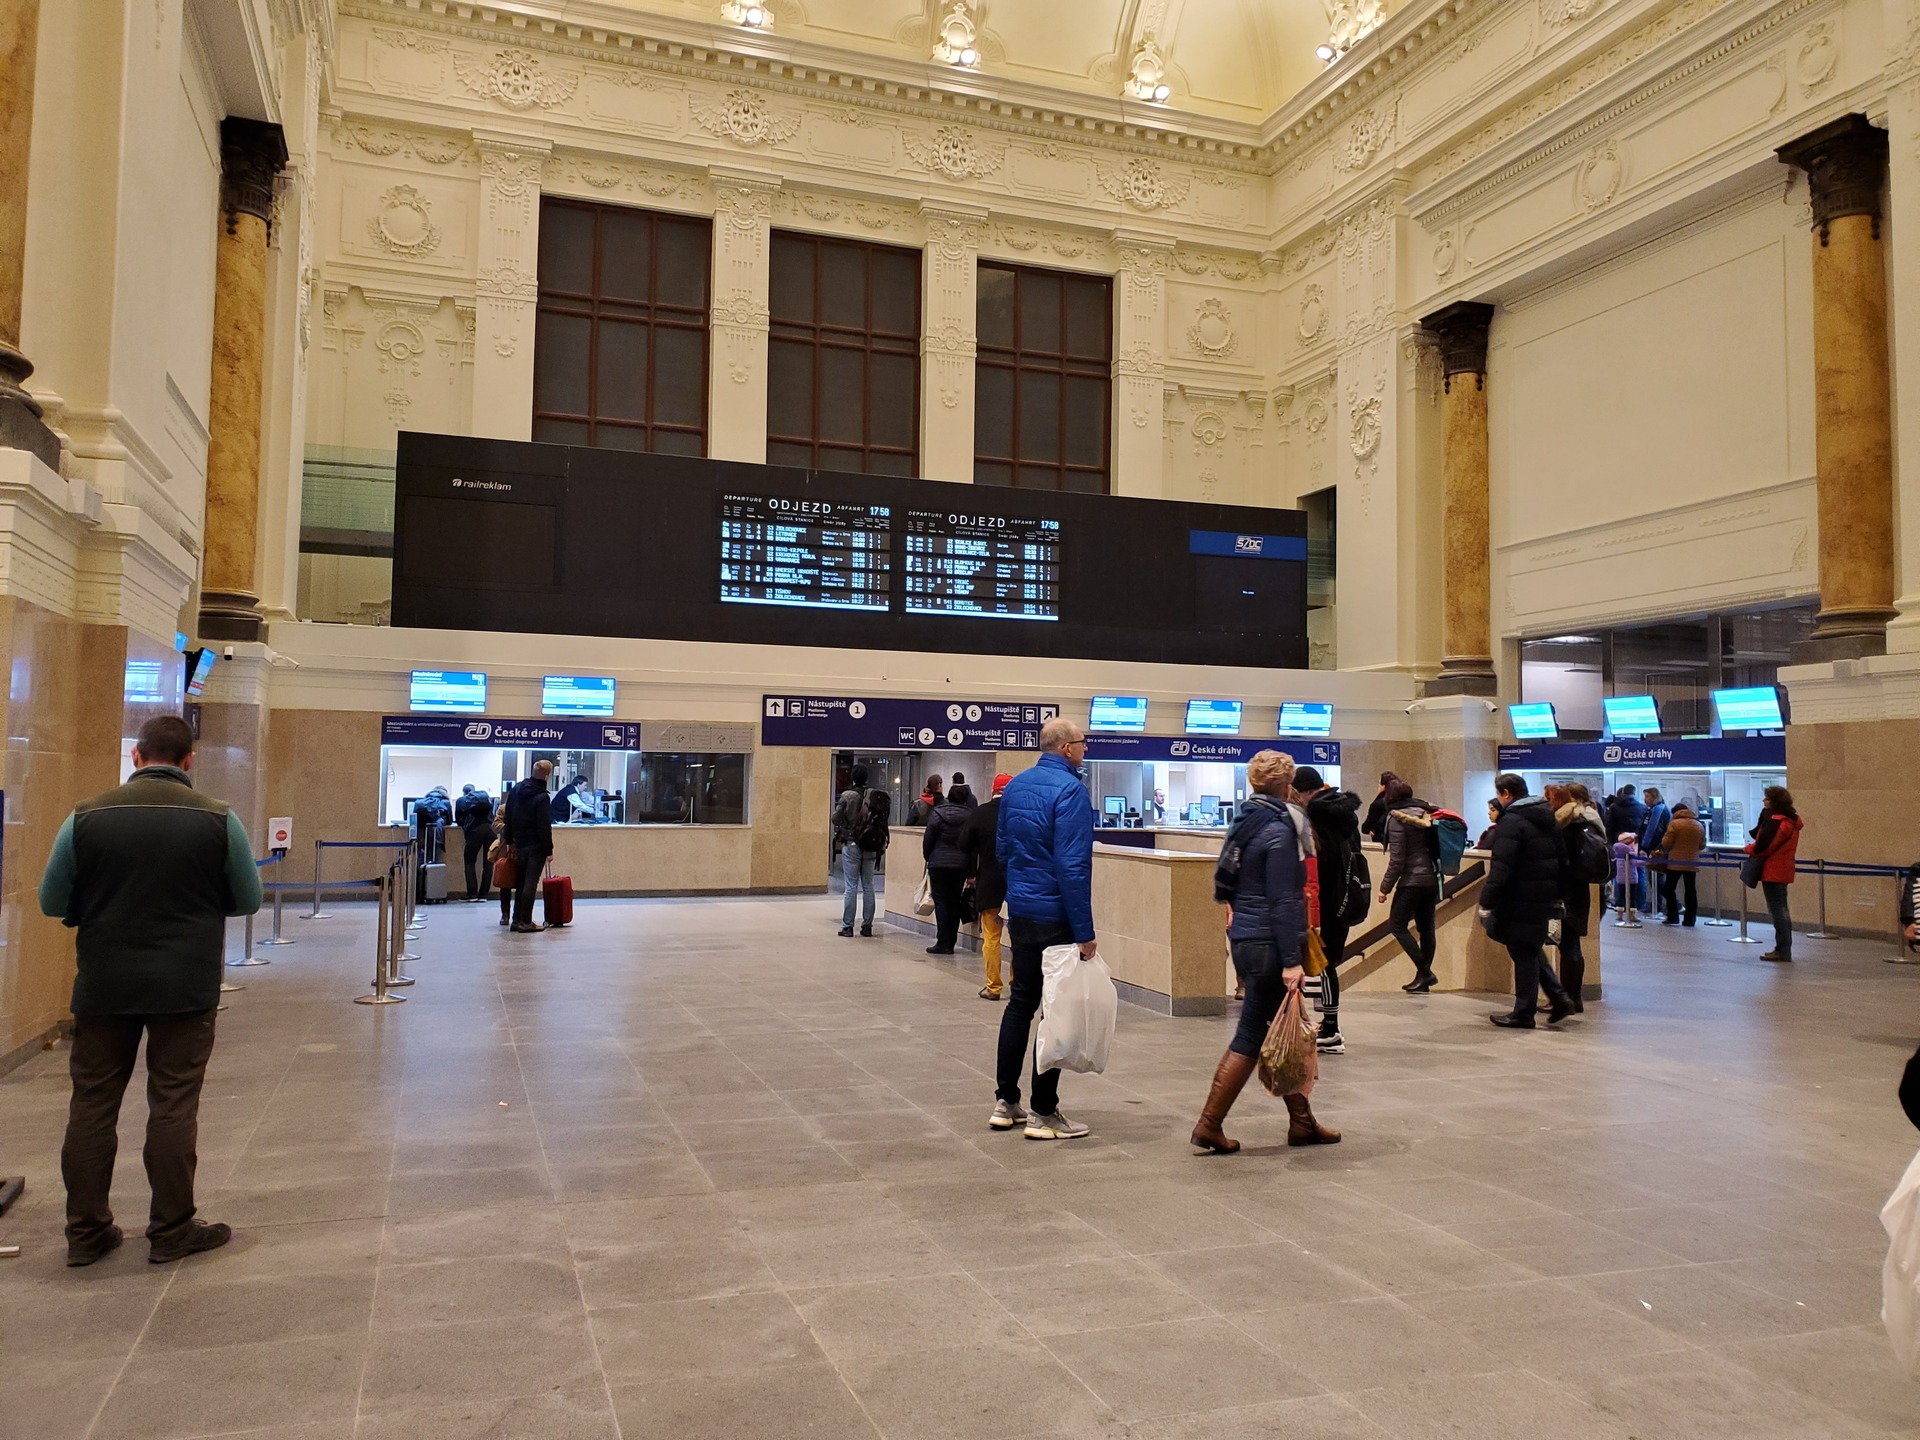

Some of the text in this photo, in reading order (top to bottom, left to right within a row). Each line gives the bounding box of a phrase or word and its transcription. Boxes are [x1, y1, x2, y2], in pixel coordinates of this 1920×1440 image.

[463, 480, 512, 491] railreklam
[723, 494, 763, 503] DEPARTURE
[768, 498, 832, 514] ODJEZD
[836, 504, 865, 512] ABFAHRT
[907, 510, 944, 518] DEPARTURE
[948, 514, 1006, 528] ODJEZD
[1040, 520, 1060, 530] 17:58
[808, 700, 847, 709] Nástupiště
[984, 705, 1020, 714] Nástupiště
[494, 725, 564, 741] České dráhy
[900, 732, 914, 740] WC
[965, 729, 1001, 737] Nástupiště
[1192, 744, 1242, 756] České dráhy
[1623, 749, 1673, 760] České dráhy
